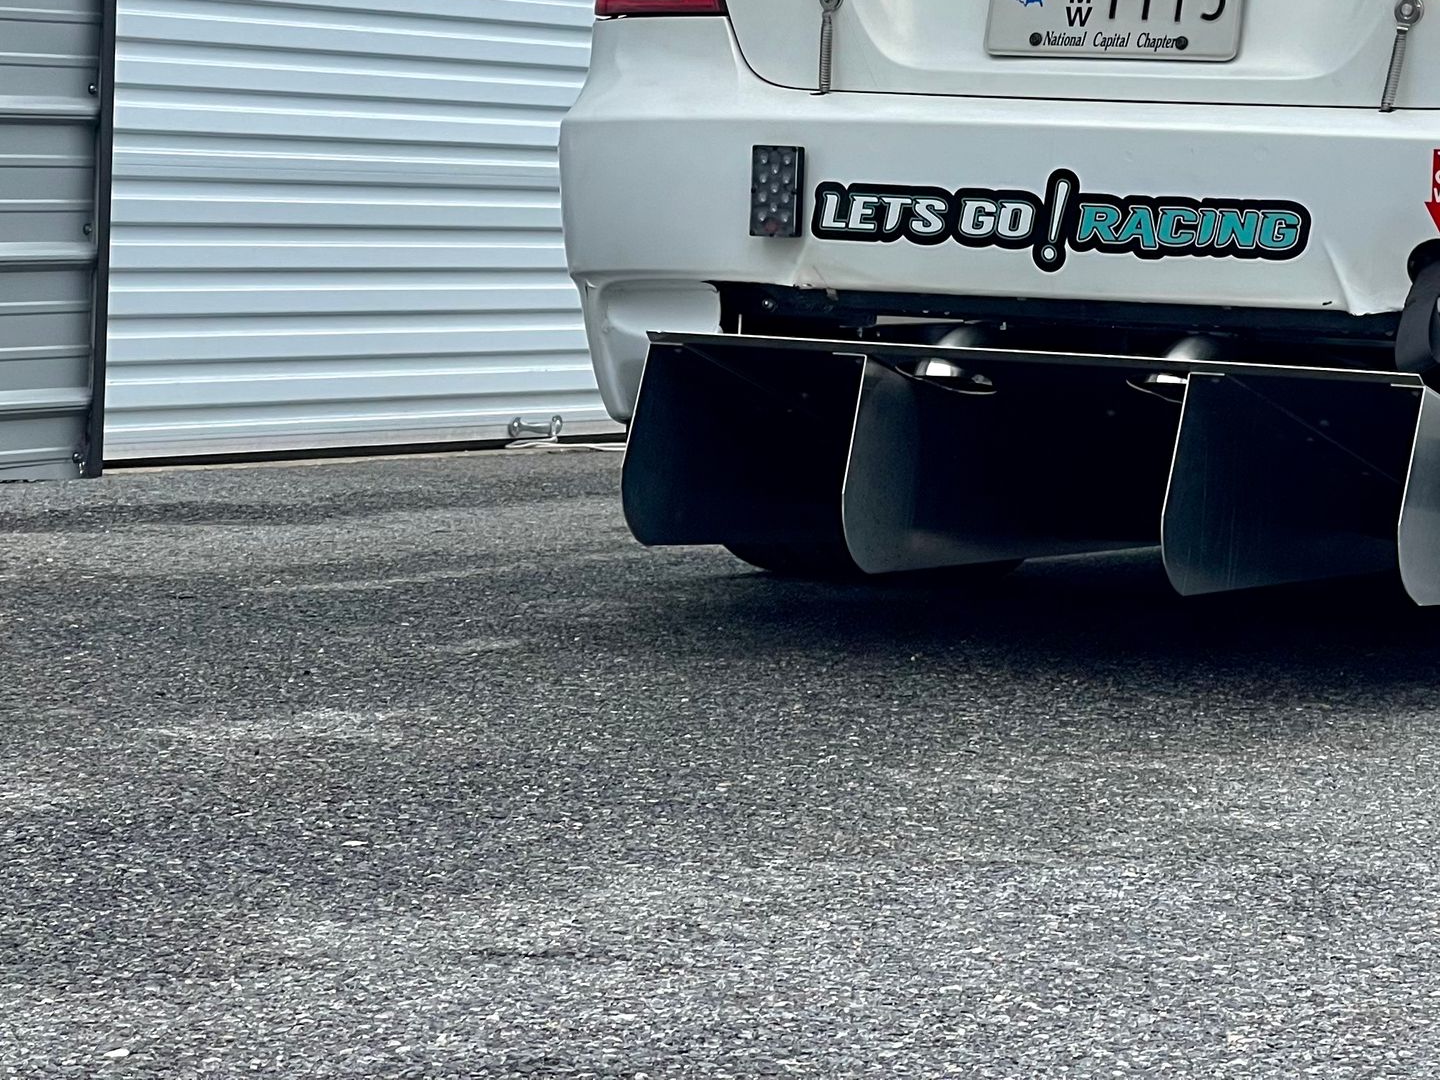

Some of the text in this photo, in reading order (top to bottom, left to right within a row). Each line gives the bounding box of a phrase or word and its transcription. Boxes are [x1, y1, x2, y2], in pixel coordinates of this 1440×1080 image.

[1042, 31, 1178, 52] National Capital Chapter
[820, 192, 948, 237] LETS
[1076, 202, 1303, 251] RACING
